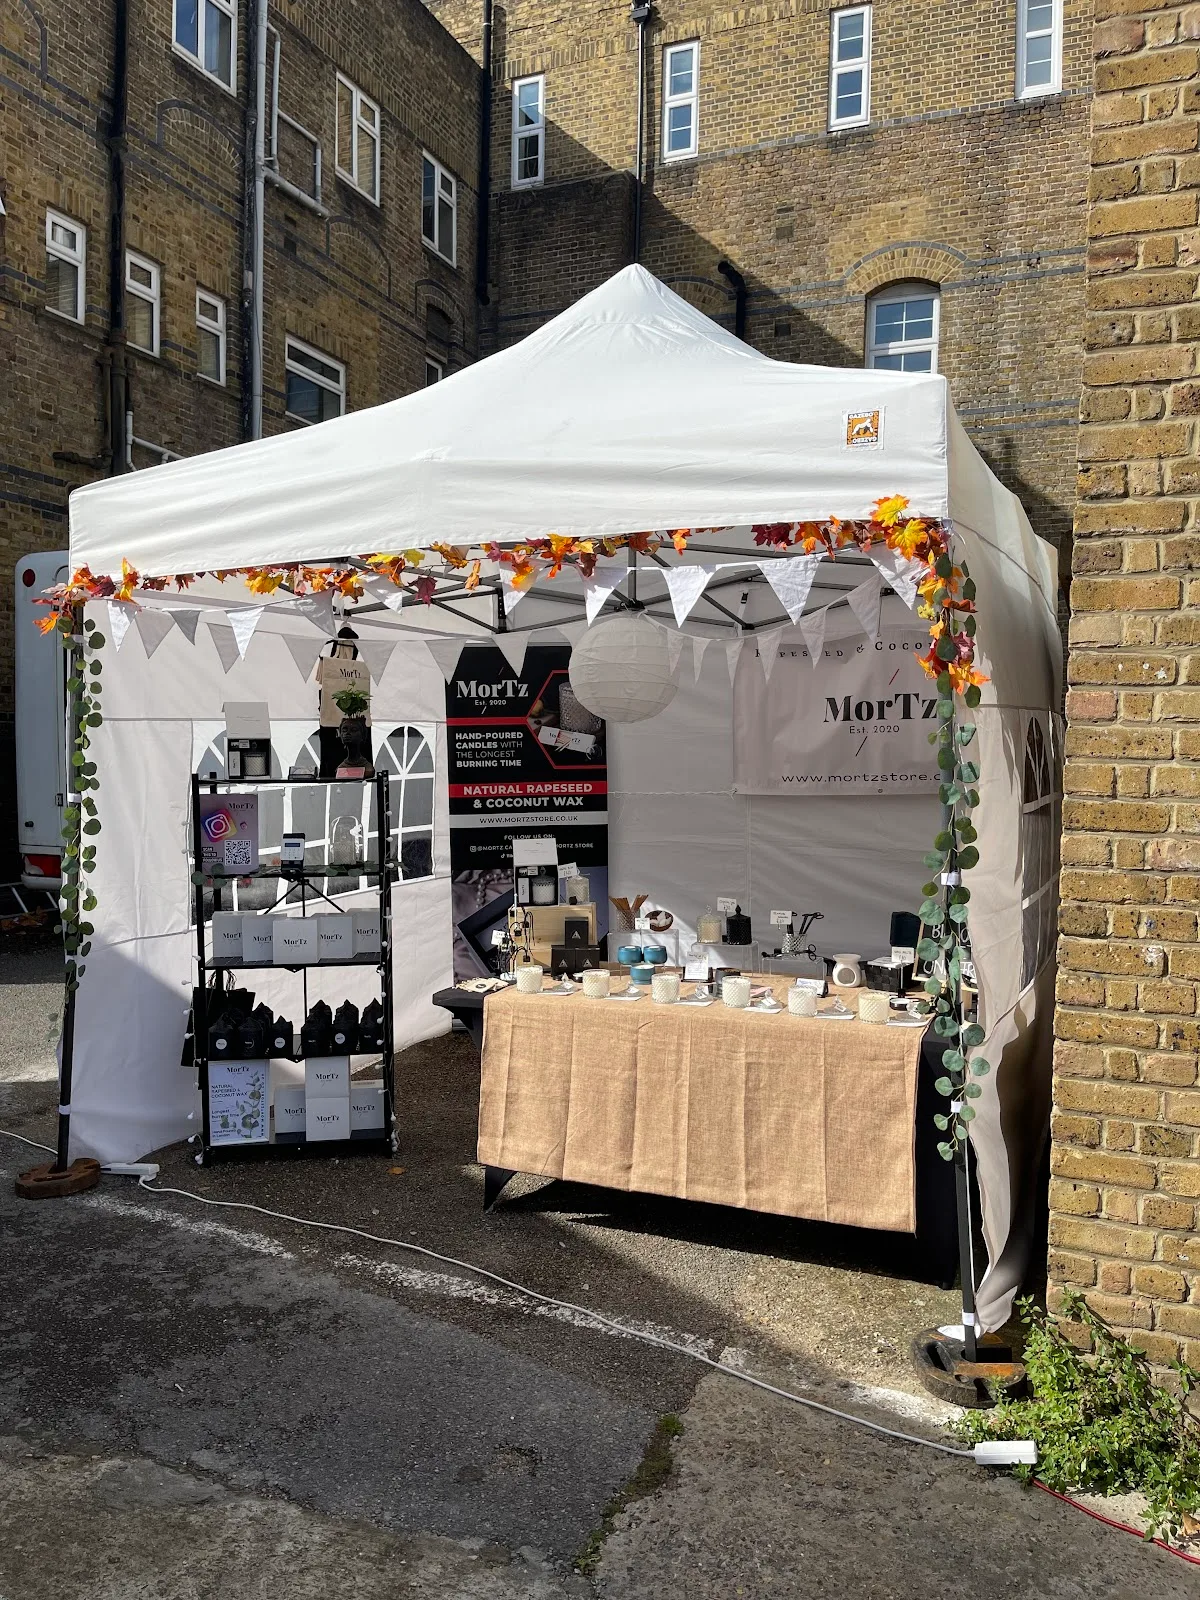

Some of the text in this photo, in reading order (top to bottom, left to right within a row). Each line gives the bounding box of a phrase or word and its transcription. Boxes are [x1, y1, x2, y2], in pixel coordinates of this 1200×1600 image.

[456, 680, 529, 698] MorTz
[823, 692, 938, 723] MorTz
[849, 724, 901, 735] Est. 2020
[455, 732, 524, 740] HAND-POURED
[475, 750, 516, 758] LONGEST
[456, 759, 522, 768] BURNING TIME
[463, 783, 593, 795] NATURAL RAPESEED
[473, 796, 584, 809] & COCONUT WAX
[479, 814, 579, 824] WWW.MORTZSTORE.CO.UK
